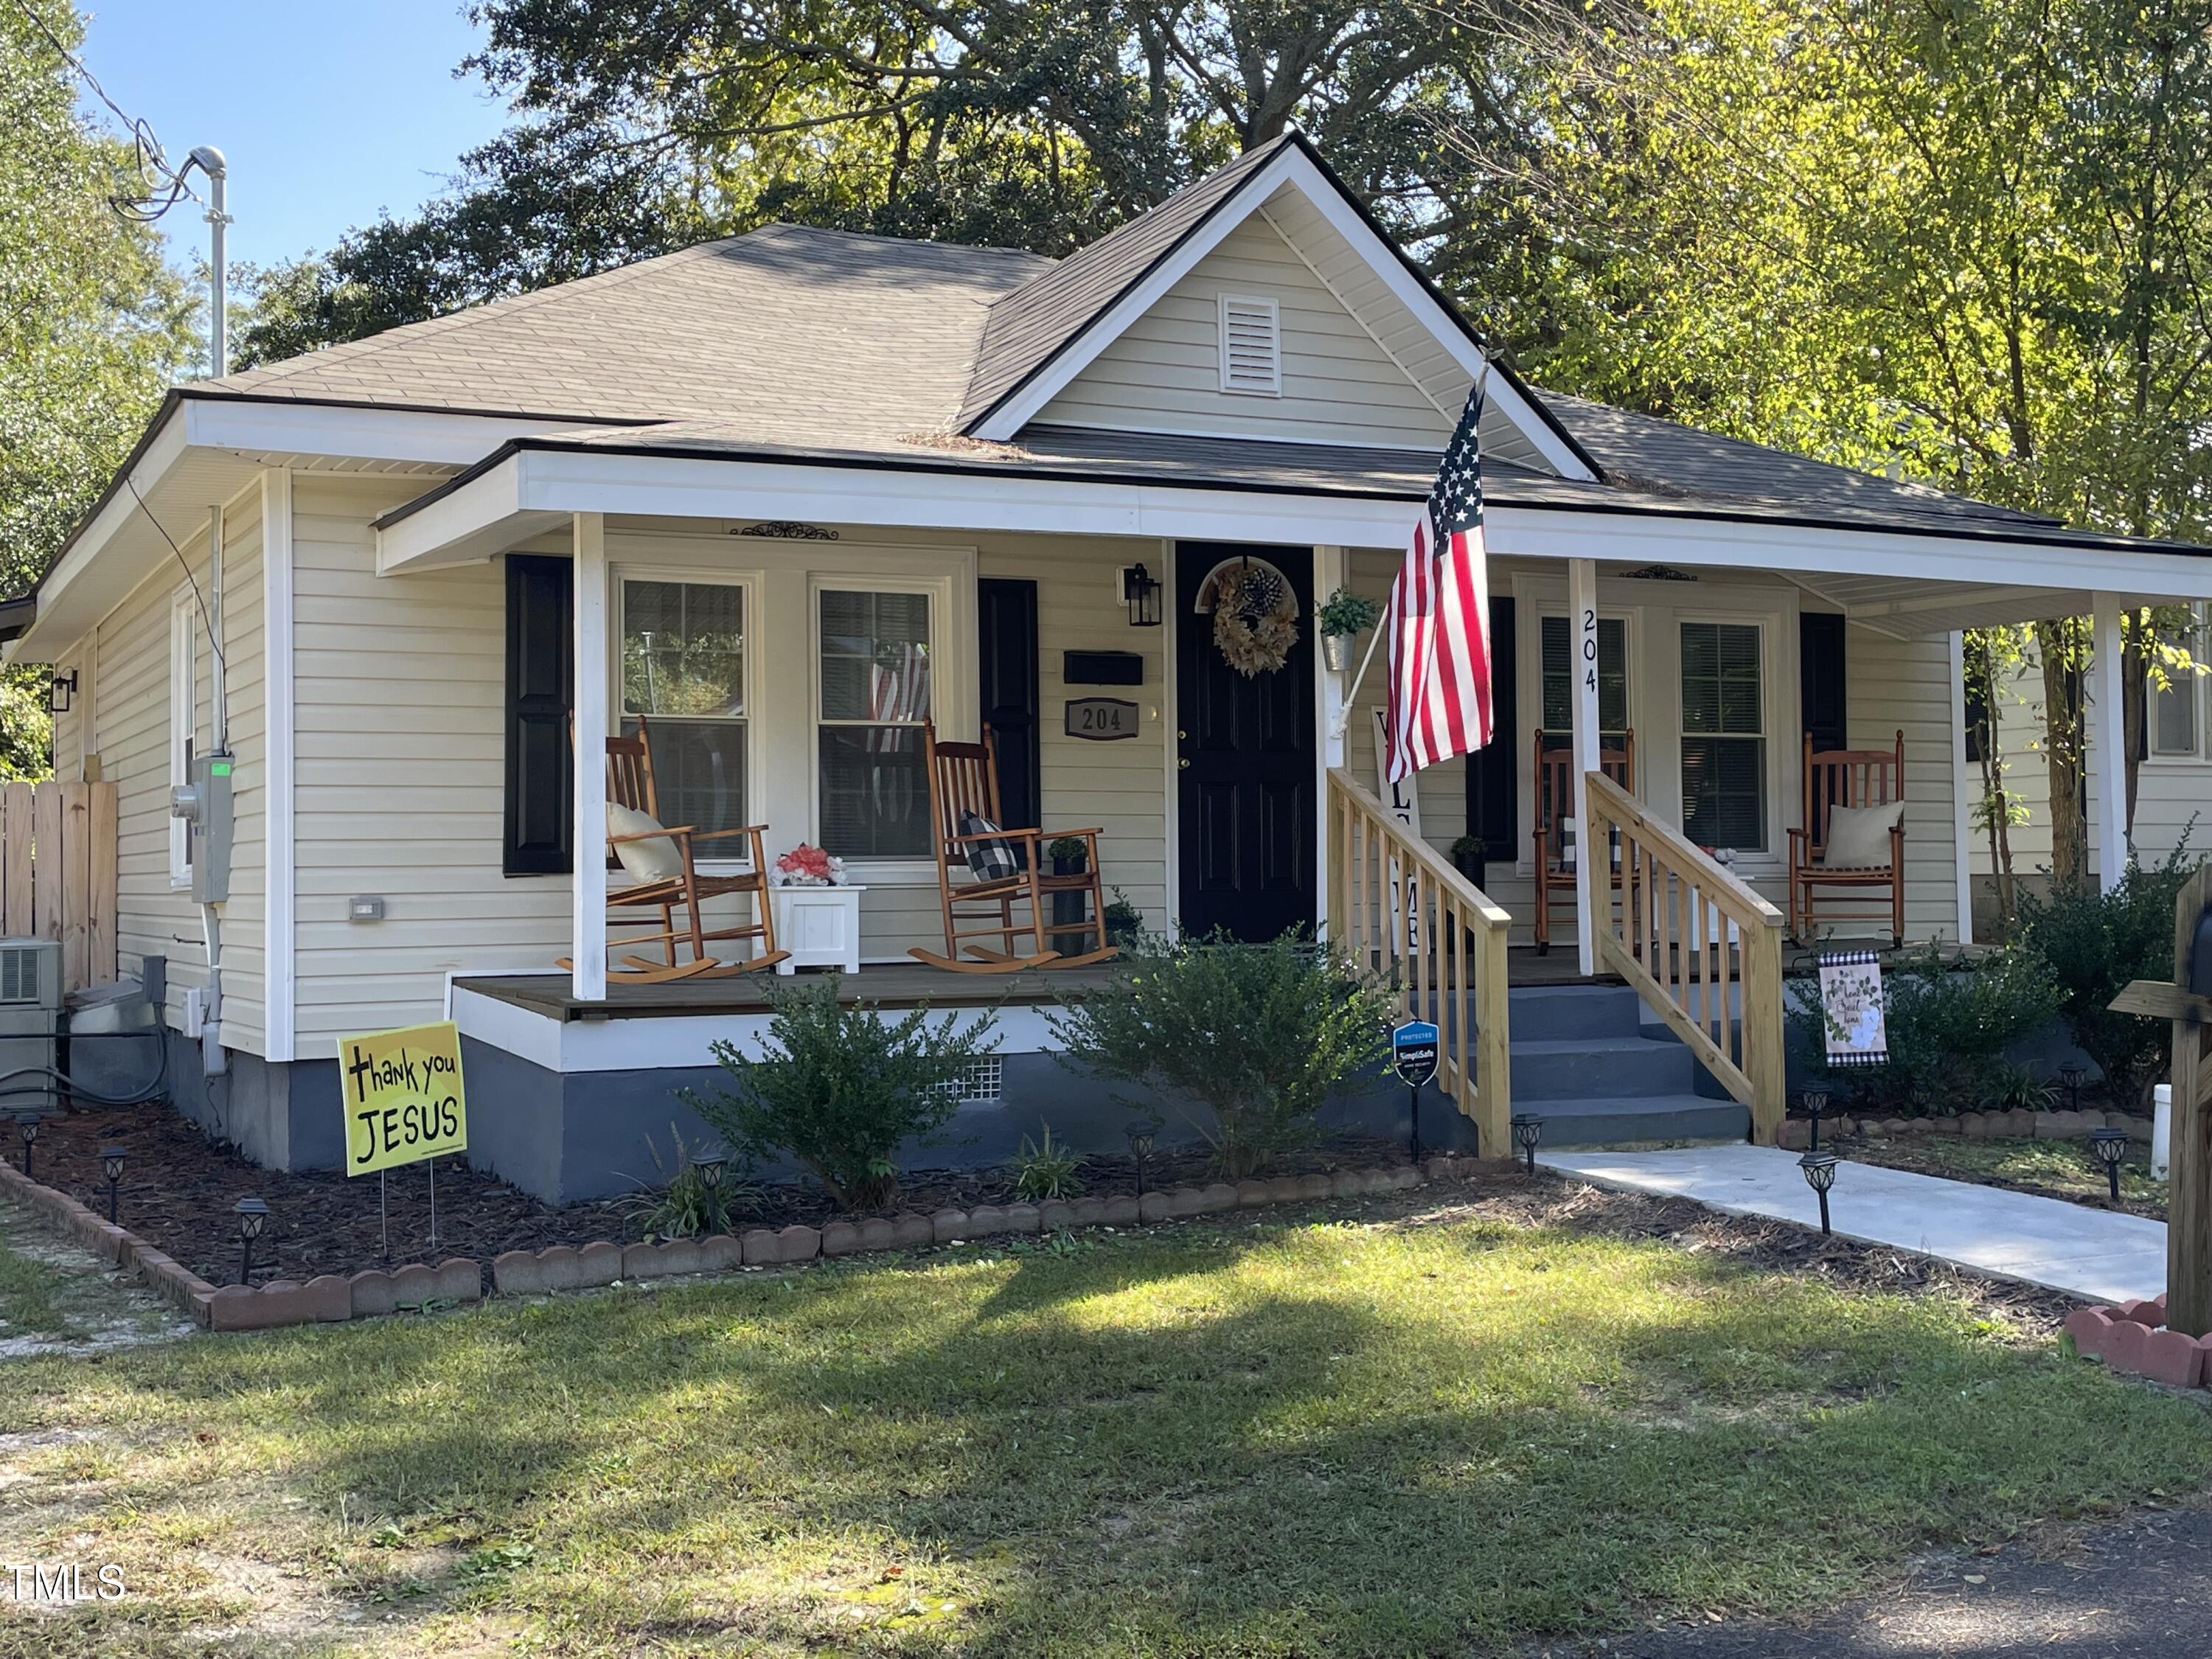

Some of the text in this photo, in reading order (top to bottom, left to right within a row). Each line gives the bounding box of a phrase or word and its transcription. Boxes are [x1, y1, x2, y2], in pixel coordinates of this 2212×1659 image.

[1584, 609, 1596, 693] 204
[1082, 708, 1121, 730] 204
[1401, 1032, 1433, 1040] PROTECTED
[422, 1056, 456, 1095] you
[357, 1096, 457, 1164] JESUS
